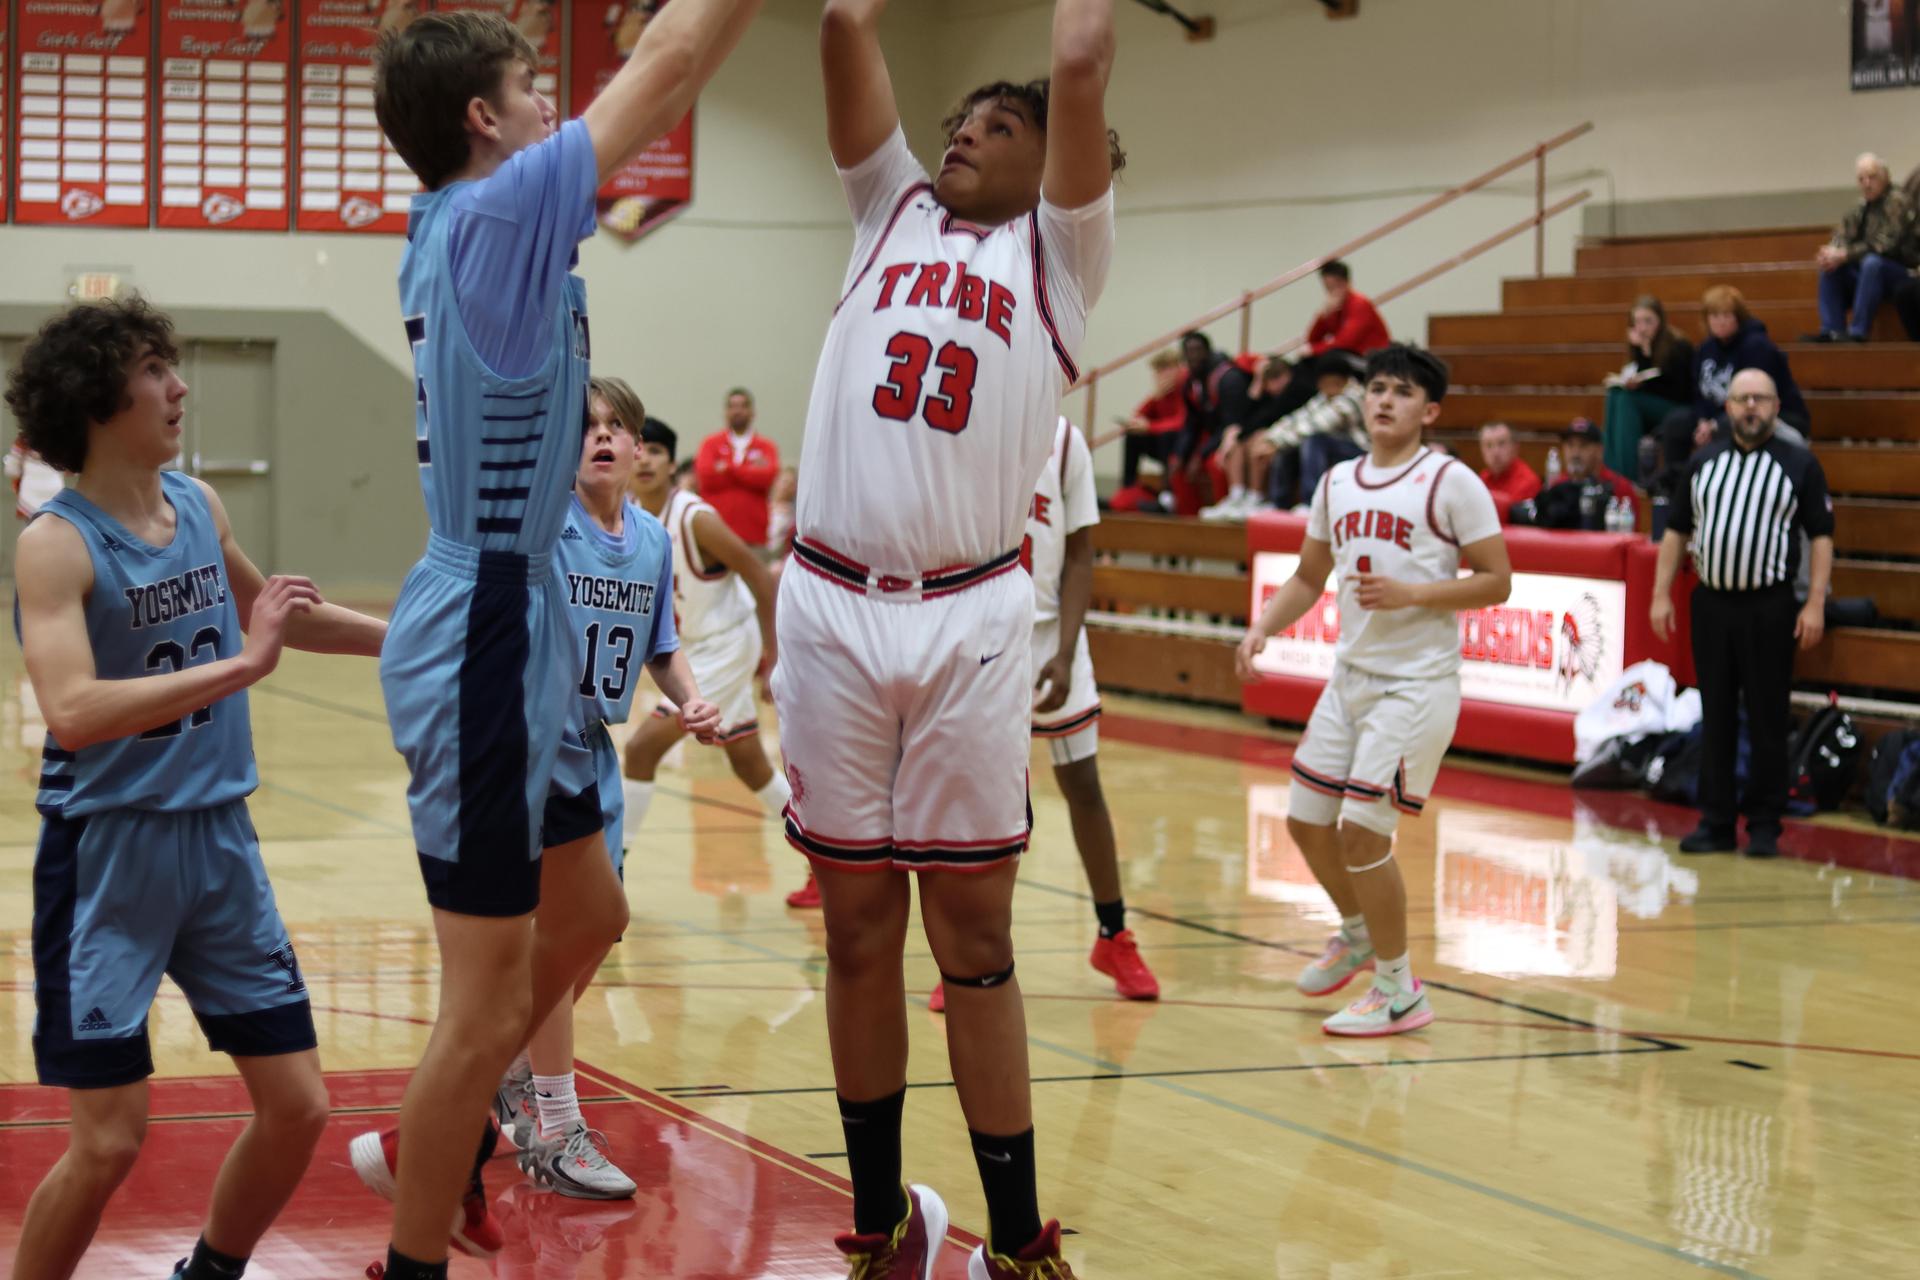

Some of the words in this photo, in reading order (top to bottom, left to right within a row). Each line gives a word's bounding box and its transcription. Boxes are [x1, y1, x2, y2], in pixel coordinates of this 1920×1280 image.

[873, 261, 1017, 350] TRIBE
[872, 331, 979, 435] 33
[1334, 509, 1414, 552] TRIBE
[568, 574, 655, 616] YOSEMITE
[579, 621, 635, 701] 13
